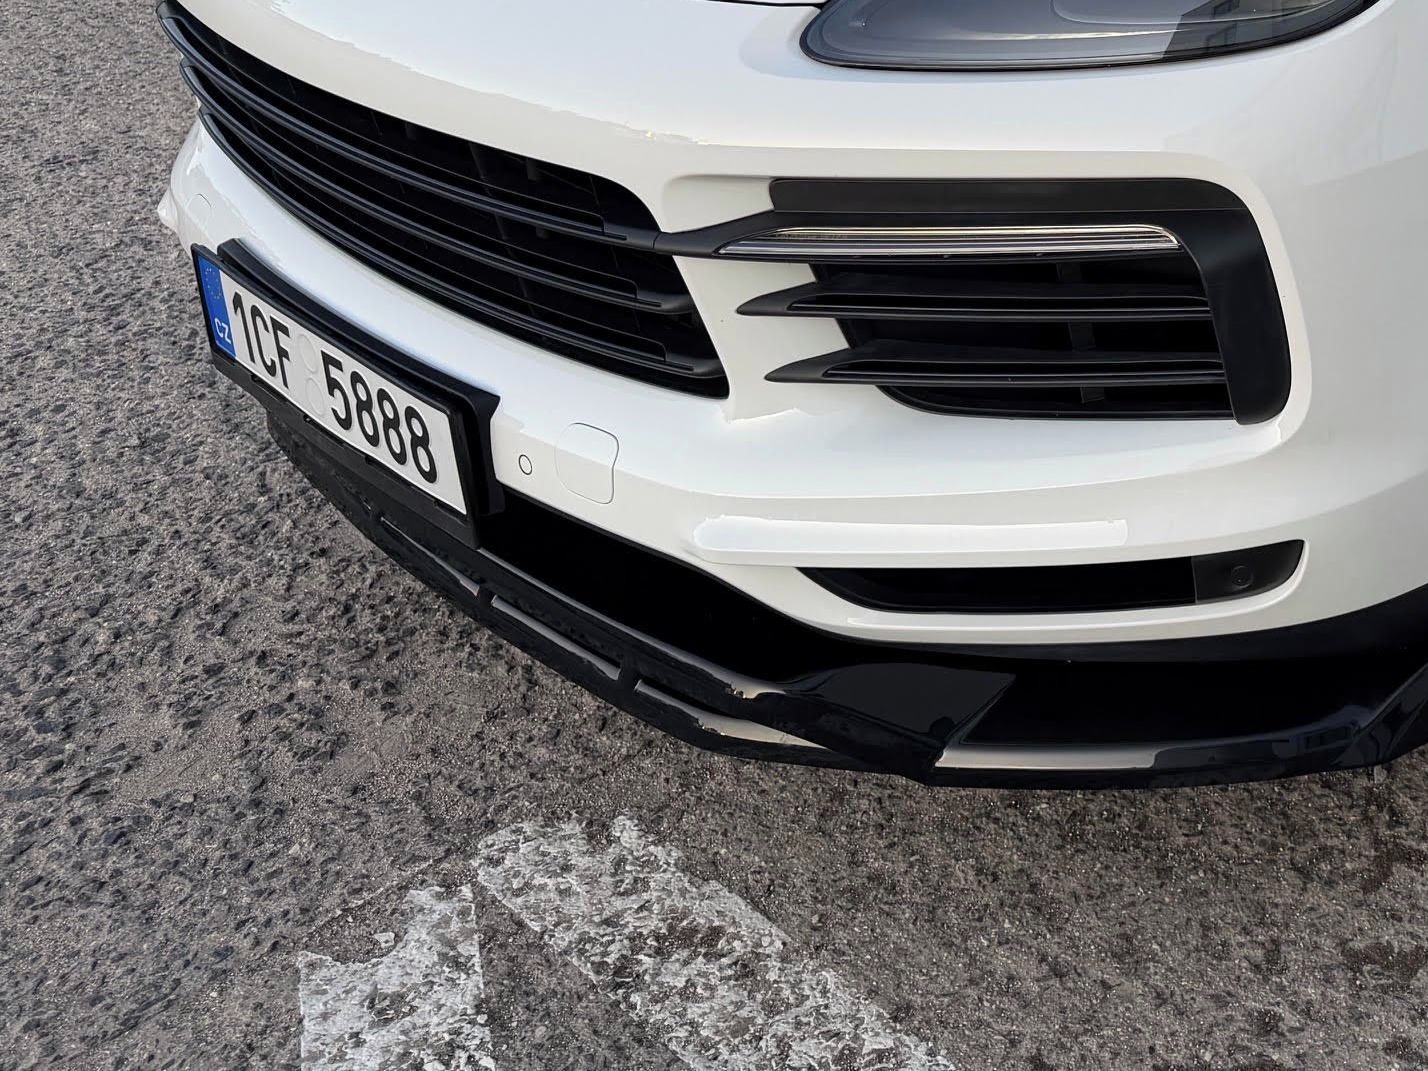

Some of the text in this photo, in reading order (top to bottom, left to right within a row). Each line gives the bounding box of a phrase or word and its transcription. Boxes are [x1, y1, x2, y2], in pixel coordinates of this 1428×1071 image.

[214, 317, 232, 344] CZ
[232, 291, 438, 485] 1CF 5888
